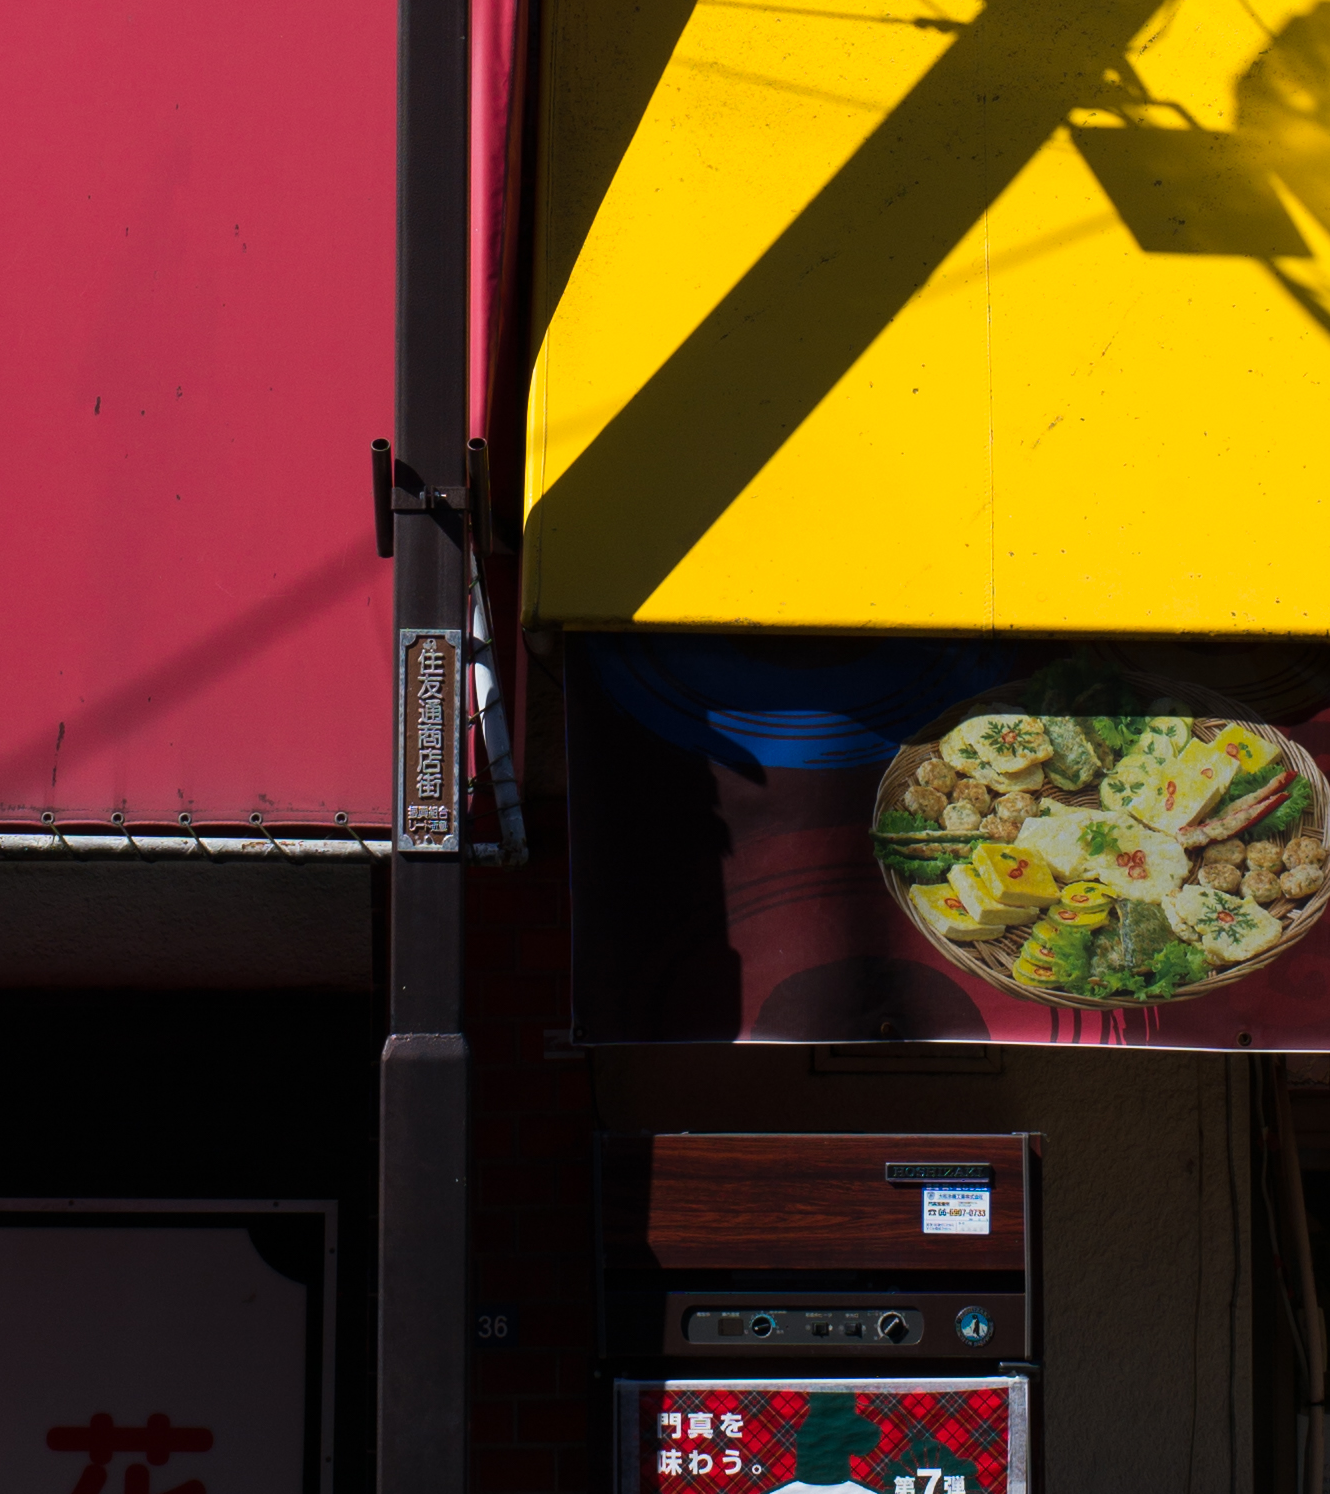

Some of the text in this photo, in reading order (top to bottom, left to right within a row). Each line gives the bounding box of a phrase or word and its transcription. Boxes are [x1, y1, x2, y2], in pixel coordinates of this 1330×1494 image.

[416, 649, 446, 799] 住友通商店街
[893, 1166, 985, 1177] HOSHIZAKI
[478, 1315, 508, 1339] 36
[657, 1411, 744, 1440] 門真を
[657, 1449, 762, 1477] 味わう。
